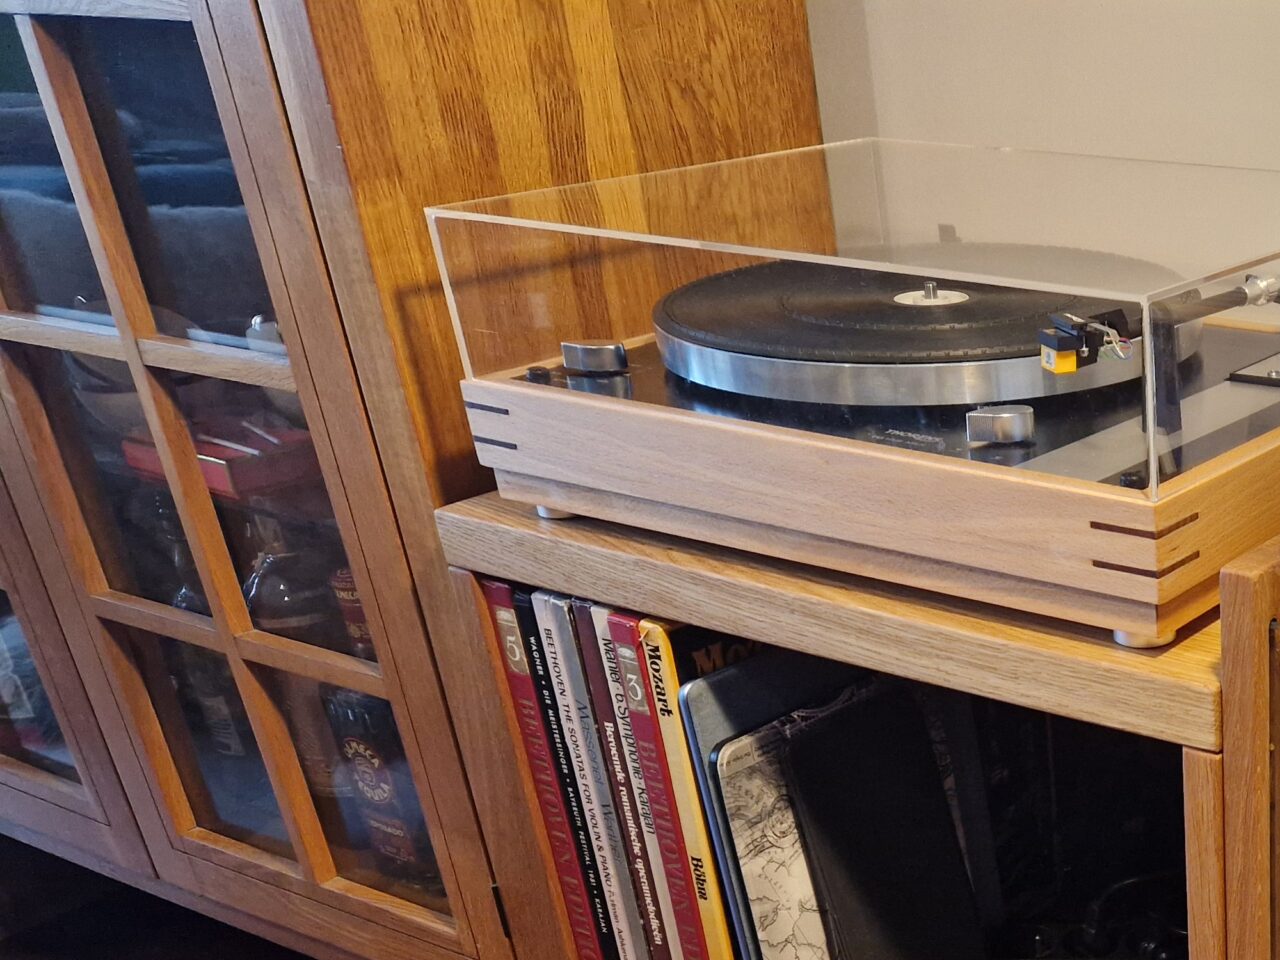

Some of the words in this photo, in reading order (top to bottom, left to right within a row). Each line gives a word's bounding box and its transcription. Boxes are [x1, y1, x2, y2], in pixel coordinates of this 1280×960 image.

[506, 635, 520, 661] 5
[626, 673, 642, 701] 3
[562, 704, 574, 724] THE
[568, 727, 588, 780] SONATAS
[576, 699, 604, 786] Massenet
[518, 697, 572, 865] BEETHOVEN
[529, 636, 544, 675] WAGNER
[542, 690, 552, 704] DIE
[547, 709, 569, 774] MEISTERSINGER
[567, 787, 582, 827] BAYREUTH
[578, 831, 592, 865] FESTIVAL
[594, 898, 608, 933] KARAJAN
[582, 783, 593, 805] FOR
[616, 704, 643, 780] Symphonie
[637, 787, 656, 835] Karajan
[645, 641, 674, 717] Mozart
[691, 856, 708, 901] Böhm
[588, 808, 602, 841] VIOLIN
[596, 844, 604, 853] &
[604, 721, 626, 783] Beroemde
[619, 786, 642, 857] romantische
[635, 858, 663, 946] operamelodieën
[640, 740, 690, 916] BEETHOVEN
[599, 855, 613, 887] PIANO
